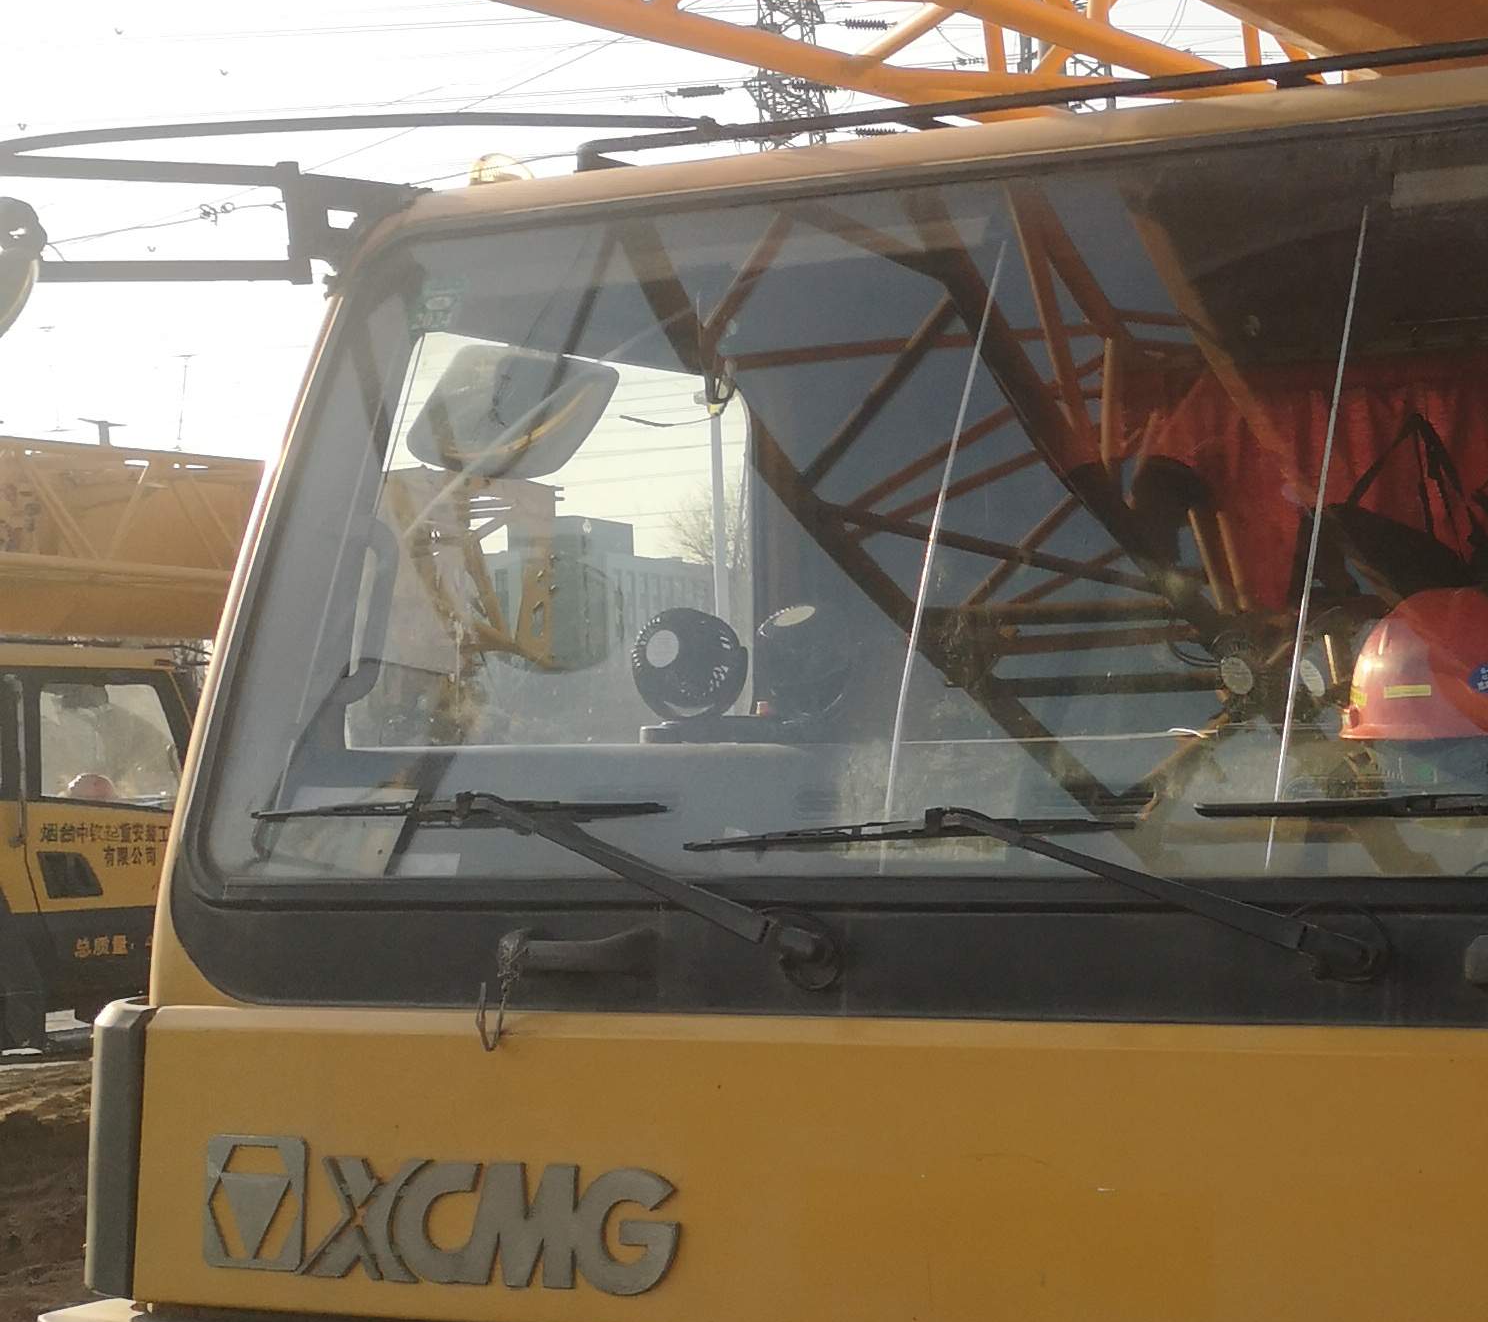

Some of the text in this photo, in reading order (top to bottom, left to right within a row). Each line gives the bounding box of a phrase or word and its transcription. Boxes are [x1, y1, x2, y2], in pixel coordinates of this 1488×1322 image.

[104, 845, 157, 867] 有限公司
[298, 1155, 682, 1297] XCMG
